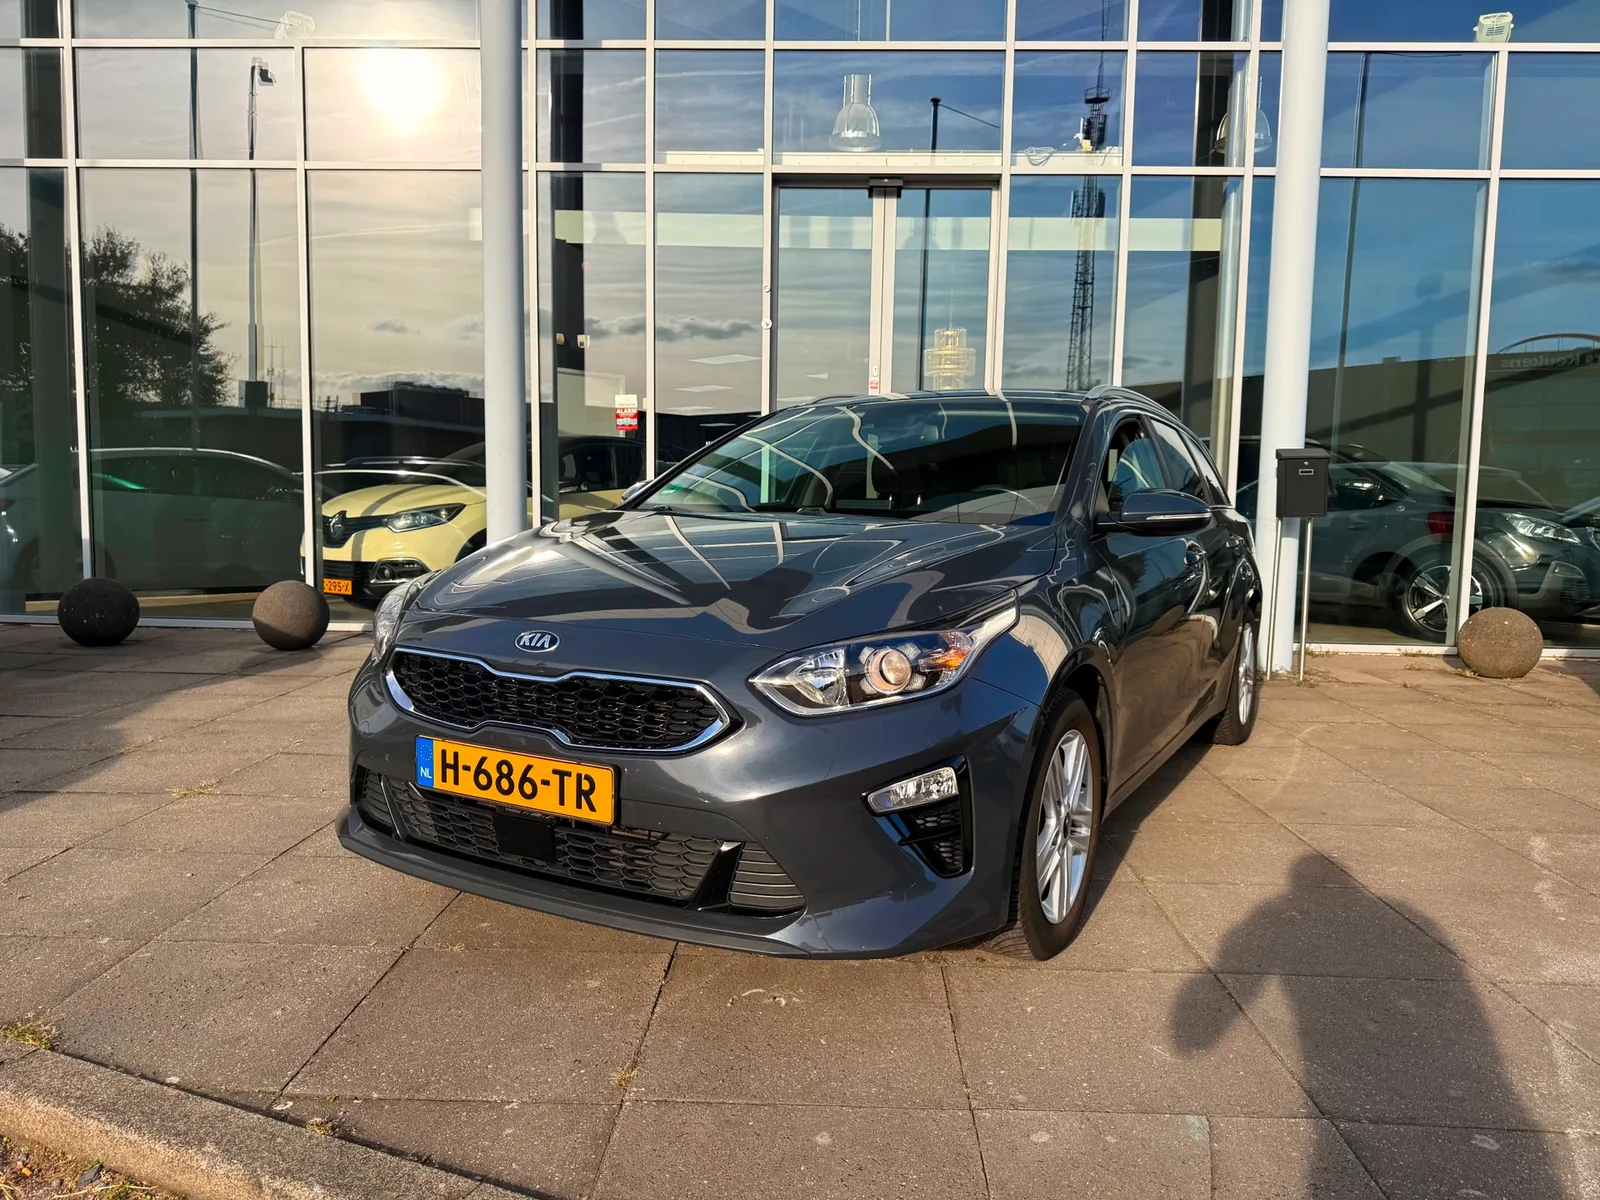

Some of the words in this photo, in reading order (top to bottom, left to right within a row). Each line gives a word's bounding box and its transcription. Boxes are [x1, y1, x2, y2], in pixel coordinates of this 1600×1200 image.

[519, 633, 551, 648] KIA
[420, 766, 433, 778] NL
[441, 749, 597, 812] H-686-TR
